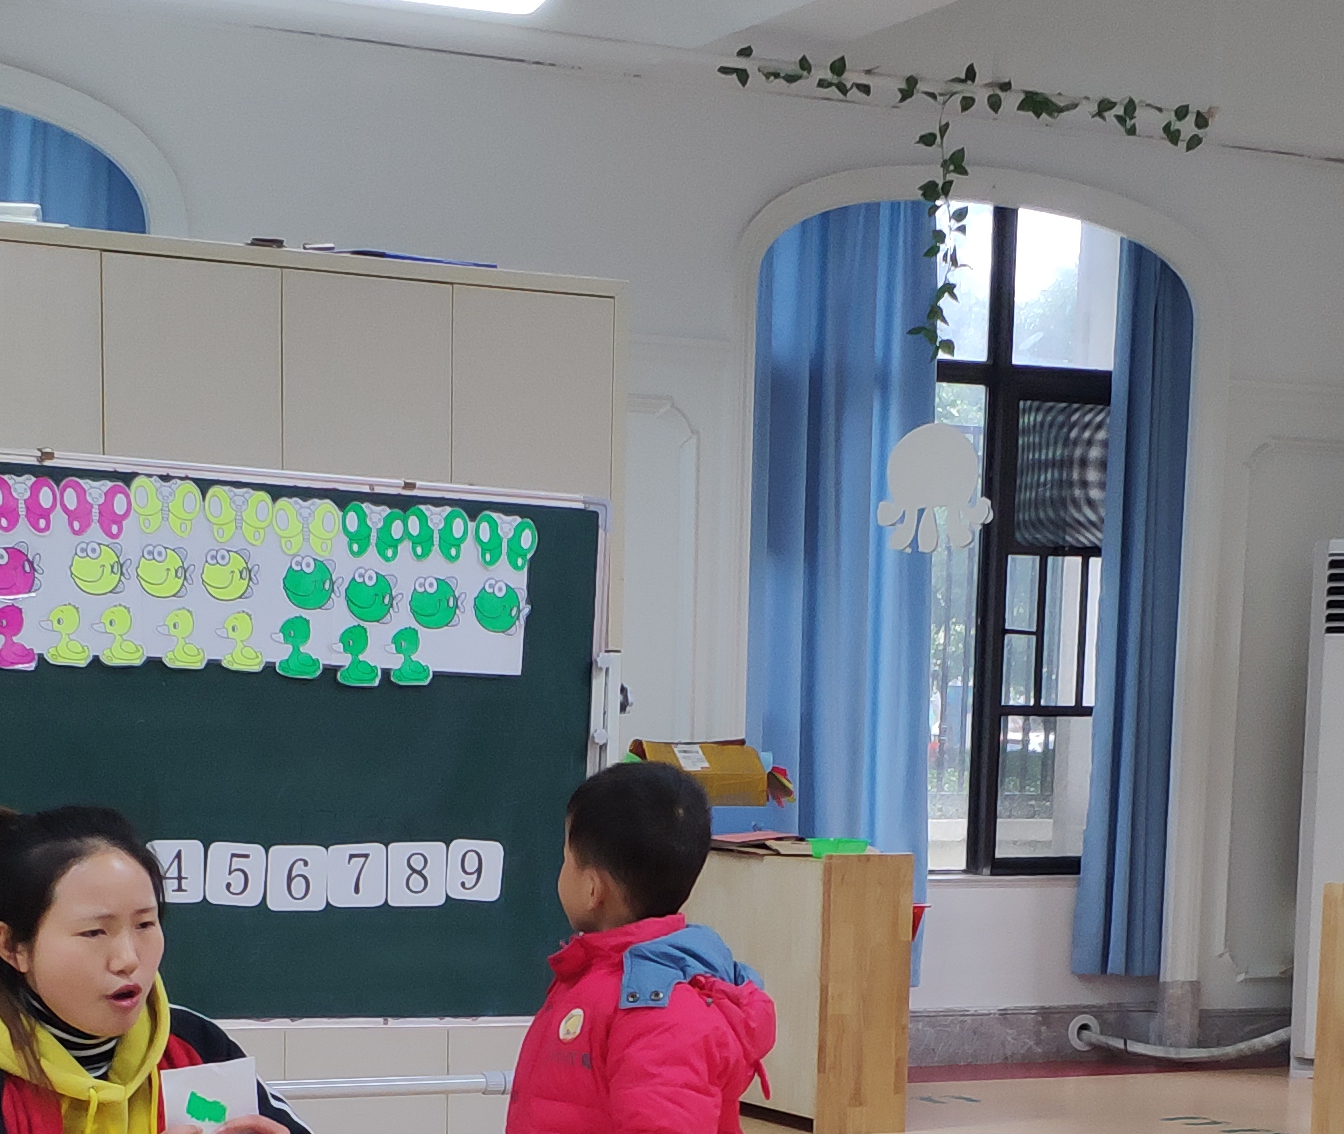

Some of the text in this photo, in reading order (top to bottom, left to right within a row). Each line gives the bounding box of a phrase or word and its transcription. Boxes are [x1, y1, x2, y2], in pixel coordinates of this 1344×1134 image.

[163, 848, 484, 901] 4 5 6 7 8 9
